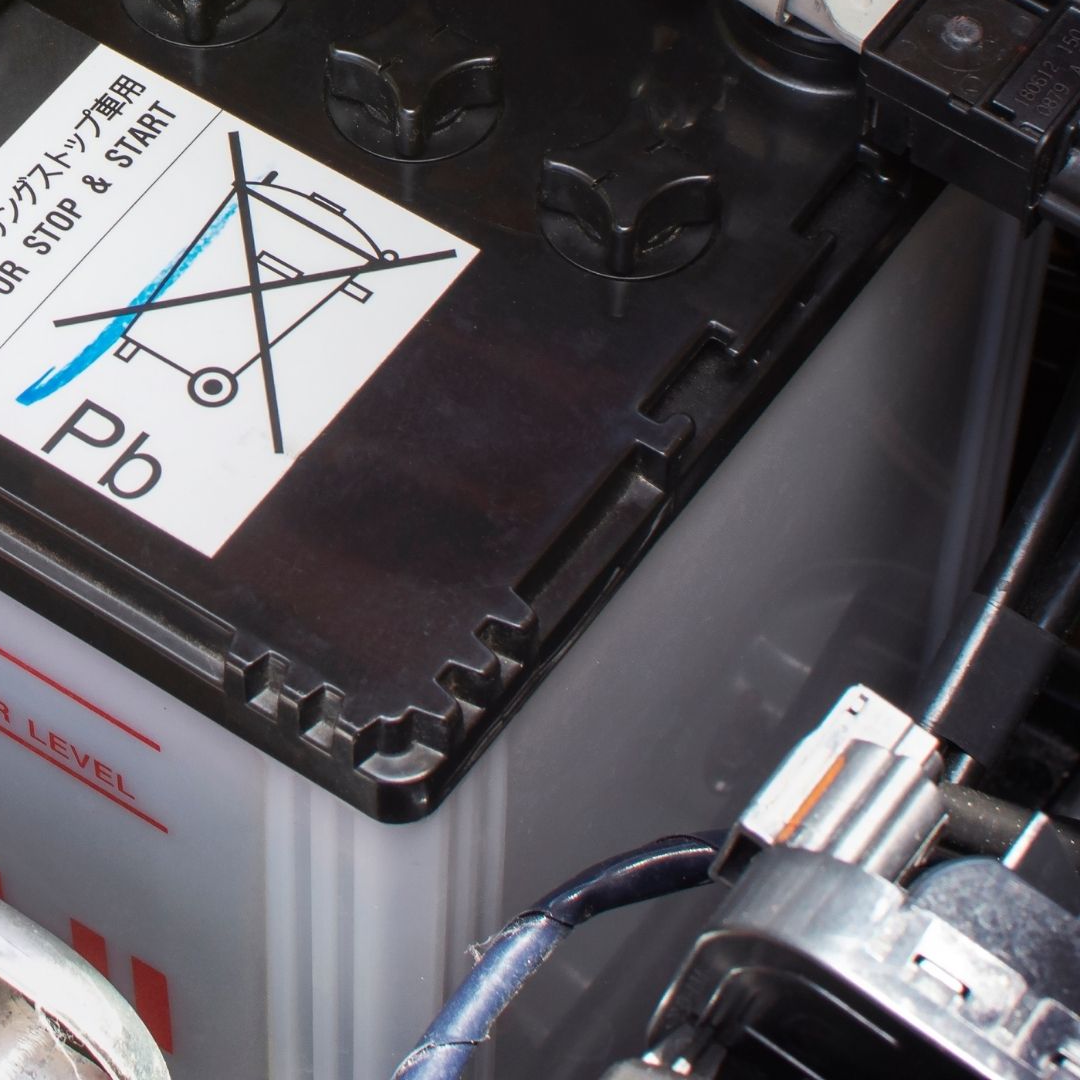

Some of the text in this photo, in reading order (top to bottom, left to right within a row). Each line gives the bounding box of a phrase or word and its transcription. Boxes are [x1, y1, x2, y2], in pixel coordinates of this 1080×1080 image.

[22, 197, 82, 255] STOP
[80, 173, 113, 194] &
[104, 99, 176, 168] START
[41, 398, 162, 499] Pb
[27, 717, 136, 801] LEVEL
